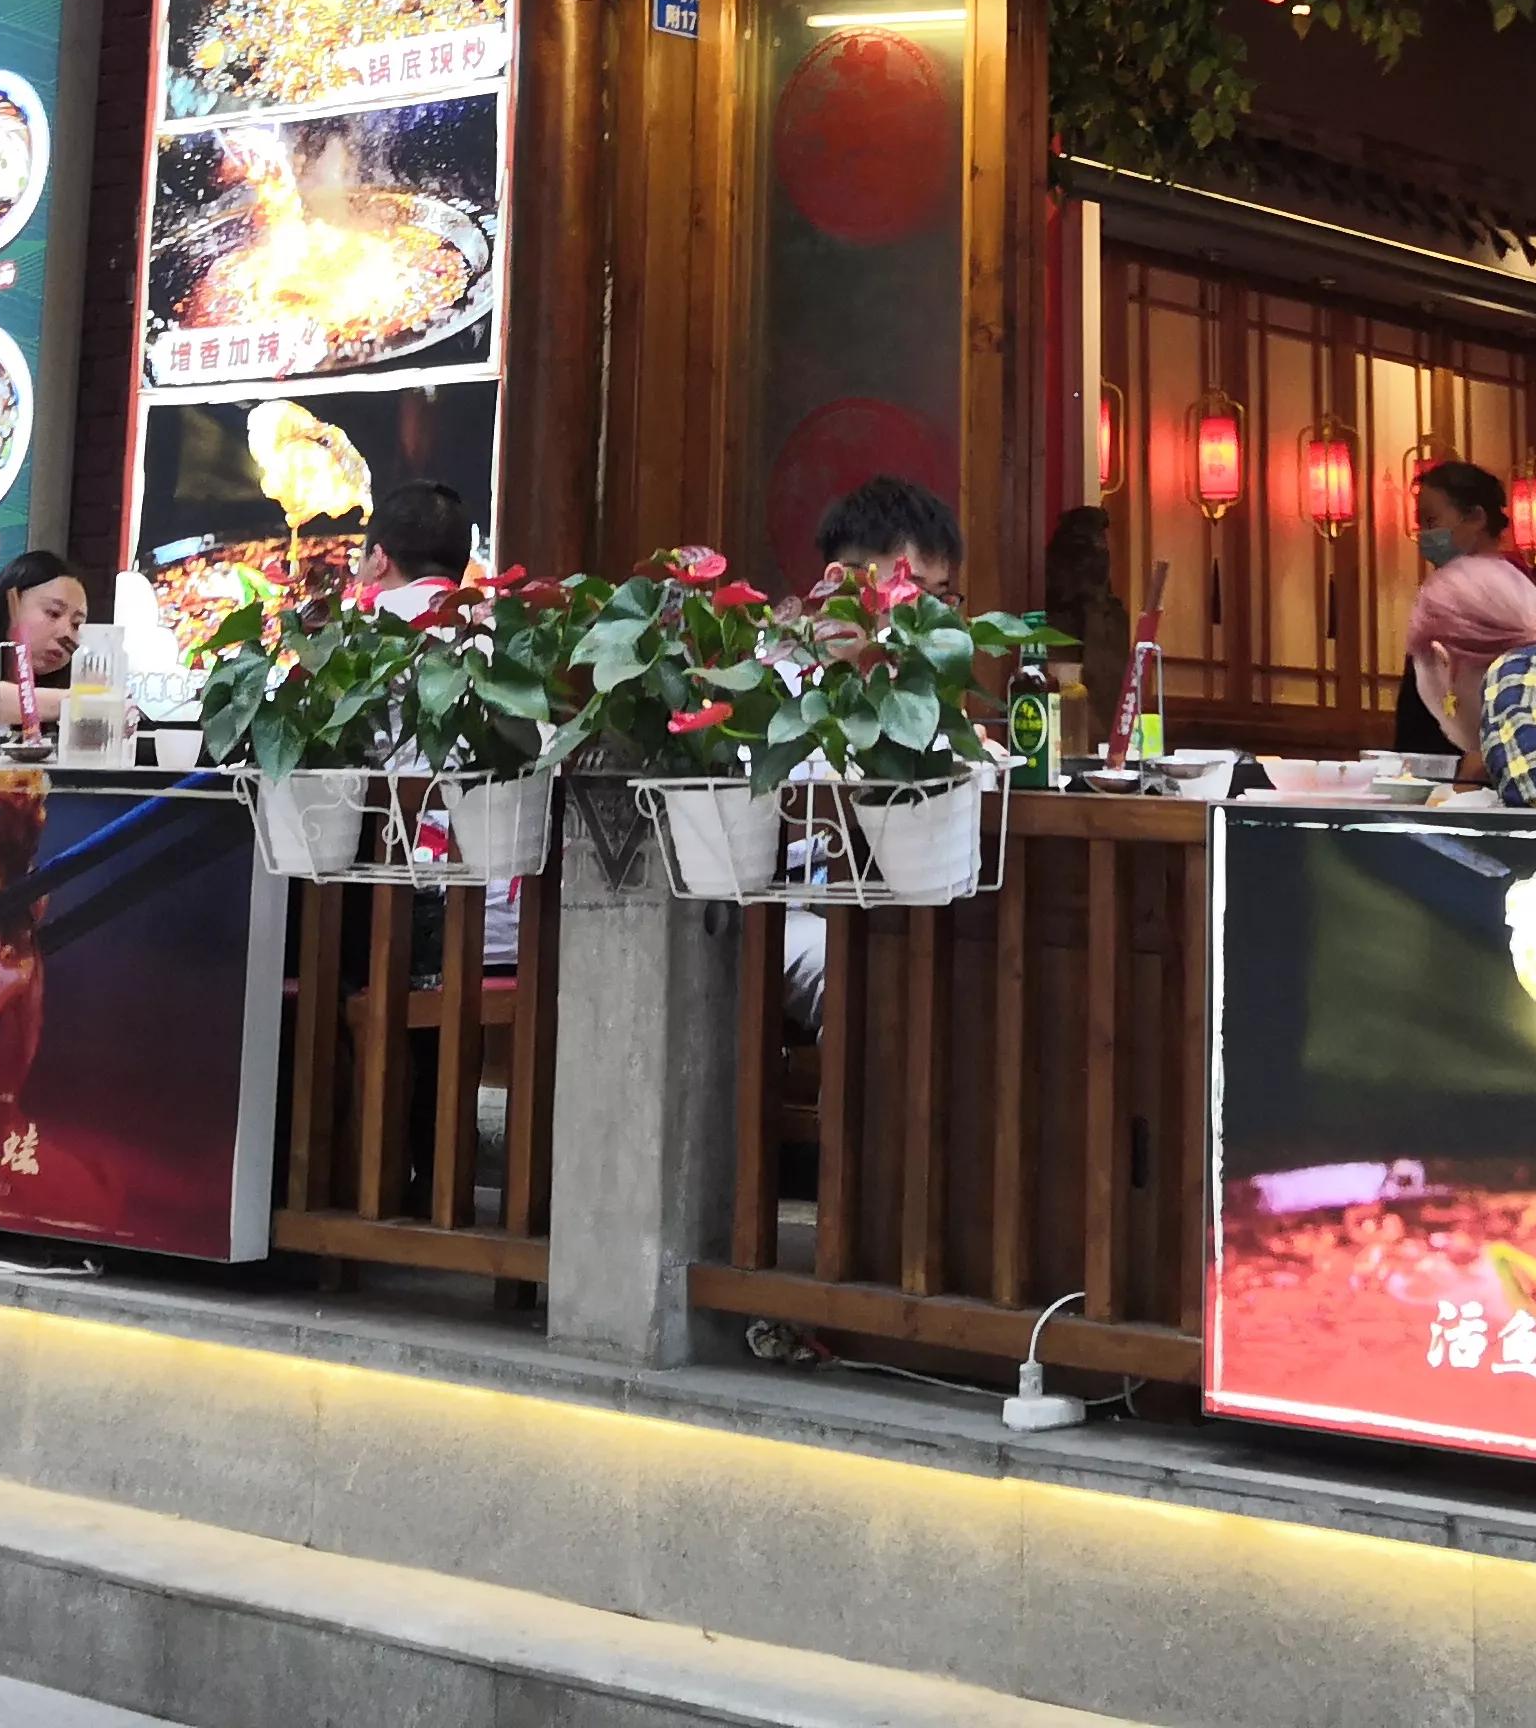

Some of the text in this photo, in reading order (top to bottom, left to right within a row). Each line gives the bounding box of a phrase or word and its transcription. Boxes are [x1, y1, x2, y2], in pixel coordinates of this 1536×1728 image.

[368, 36, 486, 86] 锅底现炒
[169, 332, 280, 372] 增香加辣
